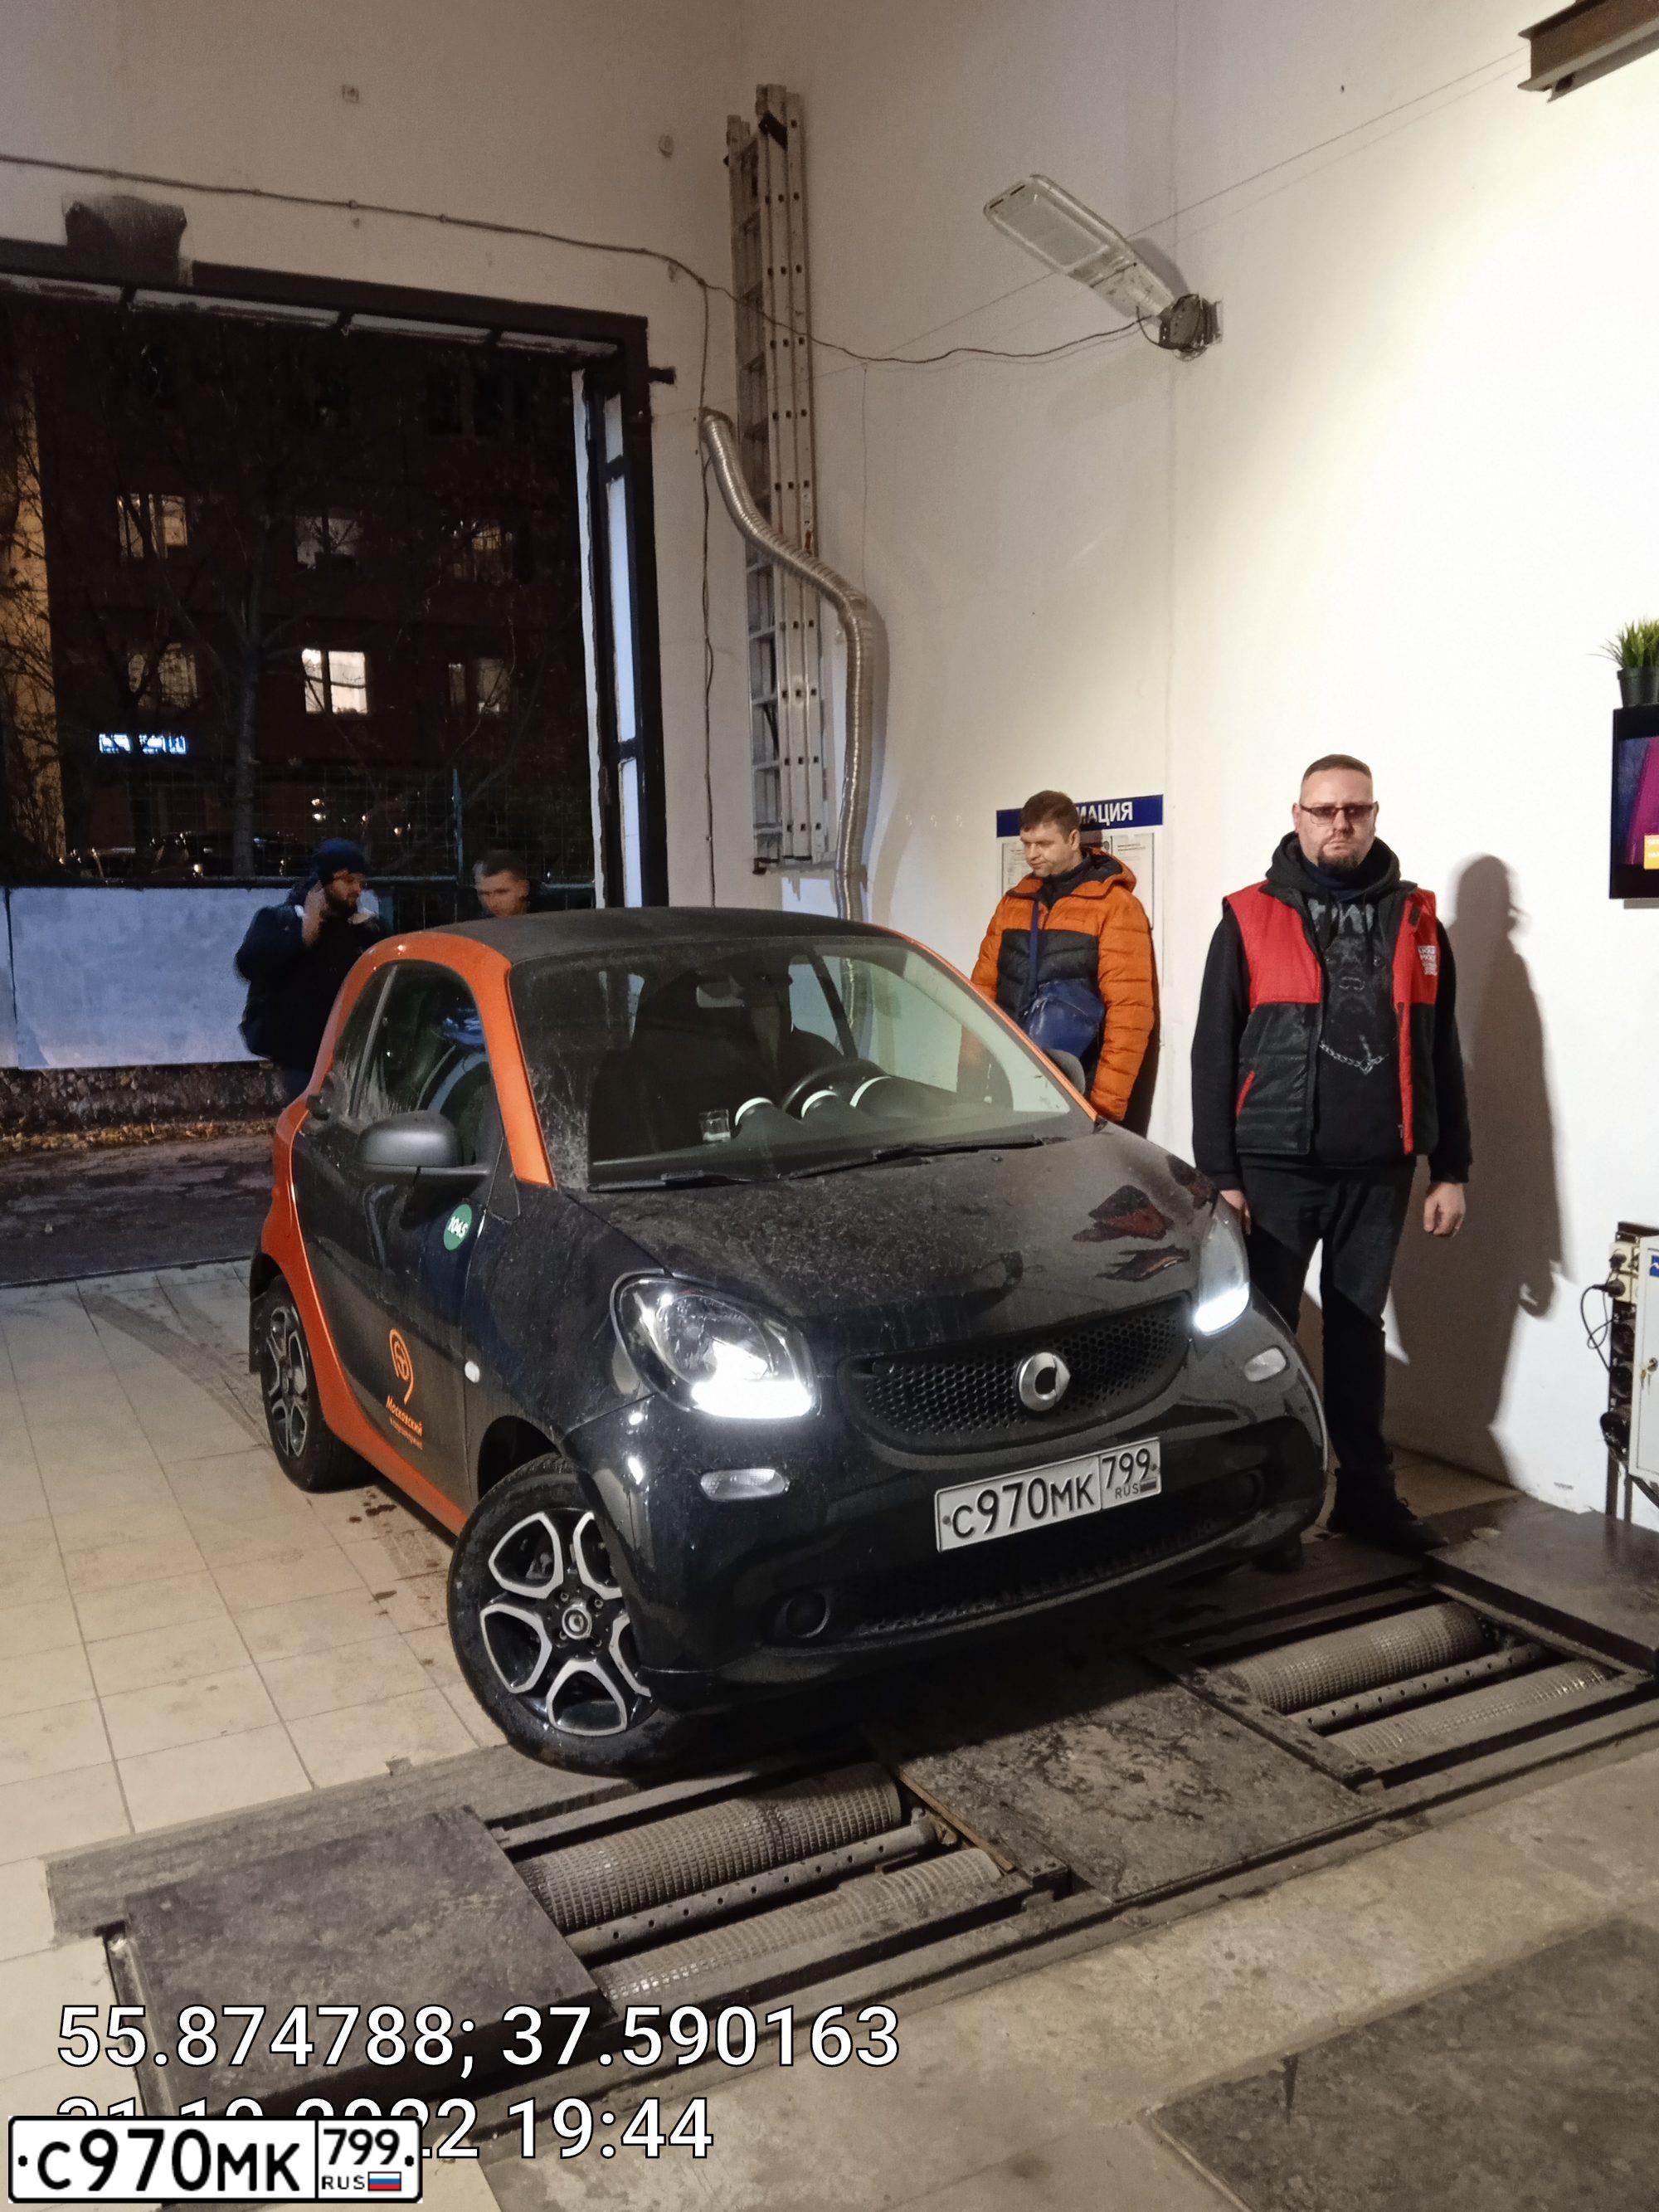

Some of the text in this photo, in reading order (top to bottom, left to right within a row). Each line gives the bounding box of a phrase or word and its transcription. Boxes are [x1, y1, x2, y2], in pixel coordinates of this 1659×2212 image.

[951, 1448, 1151, 1538] С970МК 799
[1115, 1484, 1139, 1499] RUS
